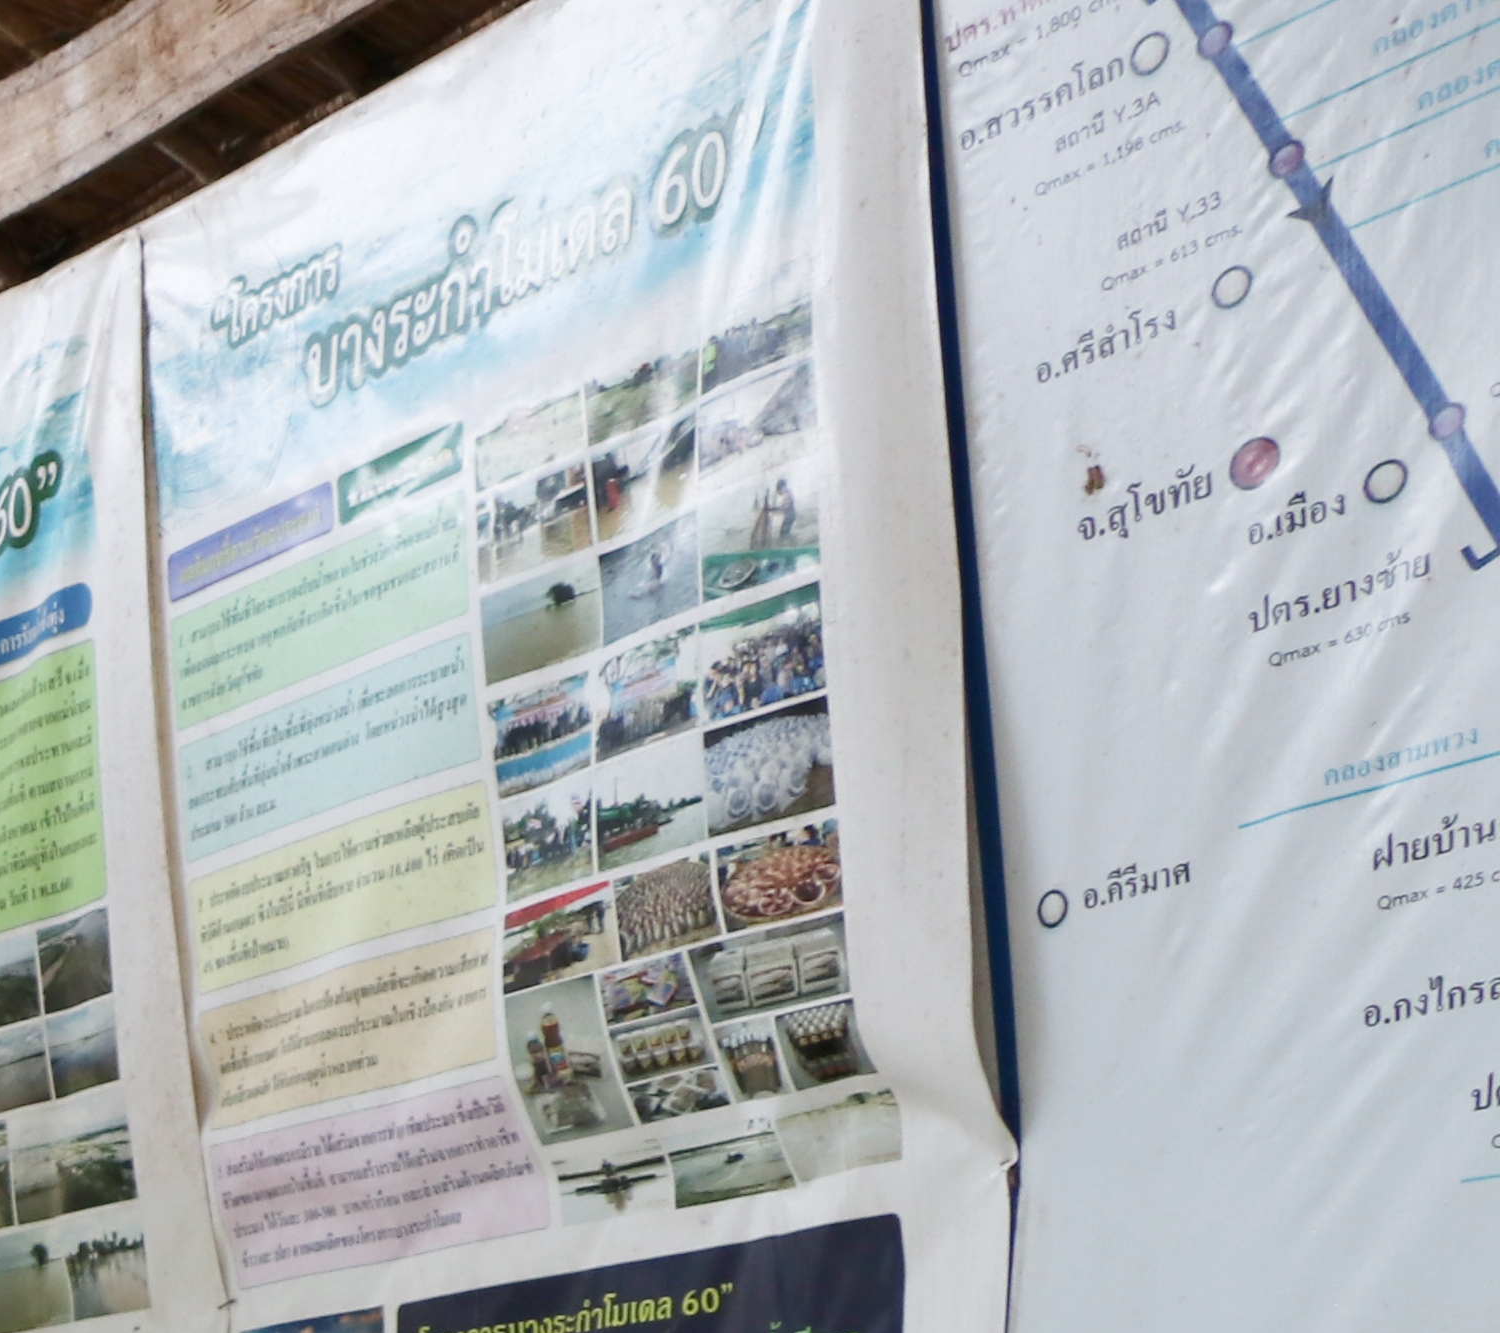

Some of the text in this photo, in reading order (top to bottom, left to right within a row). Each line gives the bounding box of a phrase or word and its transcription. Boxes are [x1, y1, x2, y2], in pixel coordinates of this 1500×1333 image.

[961, 54, 1124, 150] อ.สวรรคโลก
[1054, 107, 1106, 154] สถานี
[1034, 165, 1082, 197] Qmax
[1116, 190, 1223, 252] สถานี Y.33
[1101, 262, 1149, 292] Qmax
[1169, 239, 1199, 264] 613
[212, 247, 342, 343] “โครงการ
[306, 190, 634, 402] บางระกำโมเดล
[1037, 310, 1177, 386] อ.ศรีสำโรง
[1077, 464, 1214, 541] จ.สุโขทัย
[1248, 491, 1346, 546] อ.เมือง
[1248, 550, 1431, 634] ปตร.ยางซ้าย
[1268, 642, 1322, 668] Qmax
[1323, 727, 1480, 787] คลองสามพวง
[1084, 860, 1191, 911] อ.คีรีมาศ
[1377, 870, 1485, 911] Qmax 425
[681, 1283, 734, 1318] 60”
